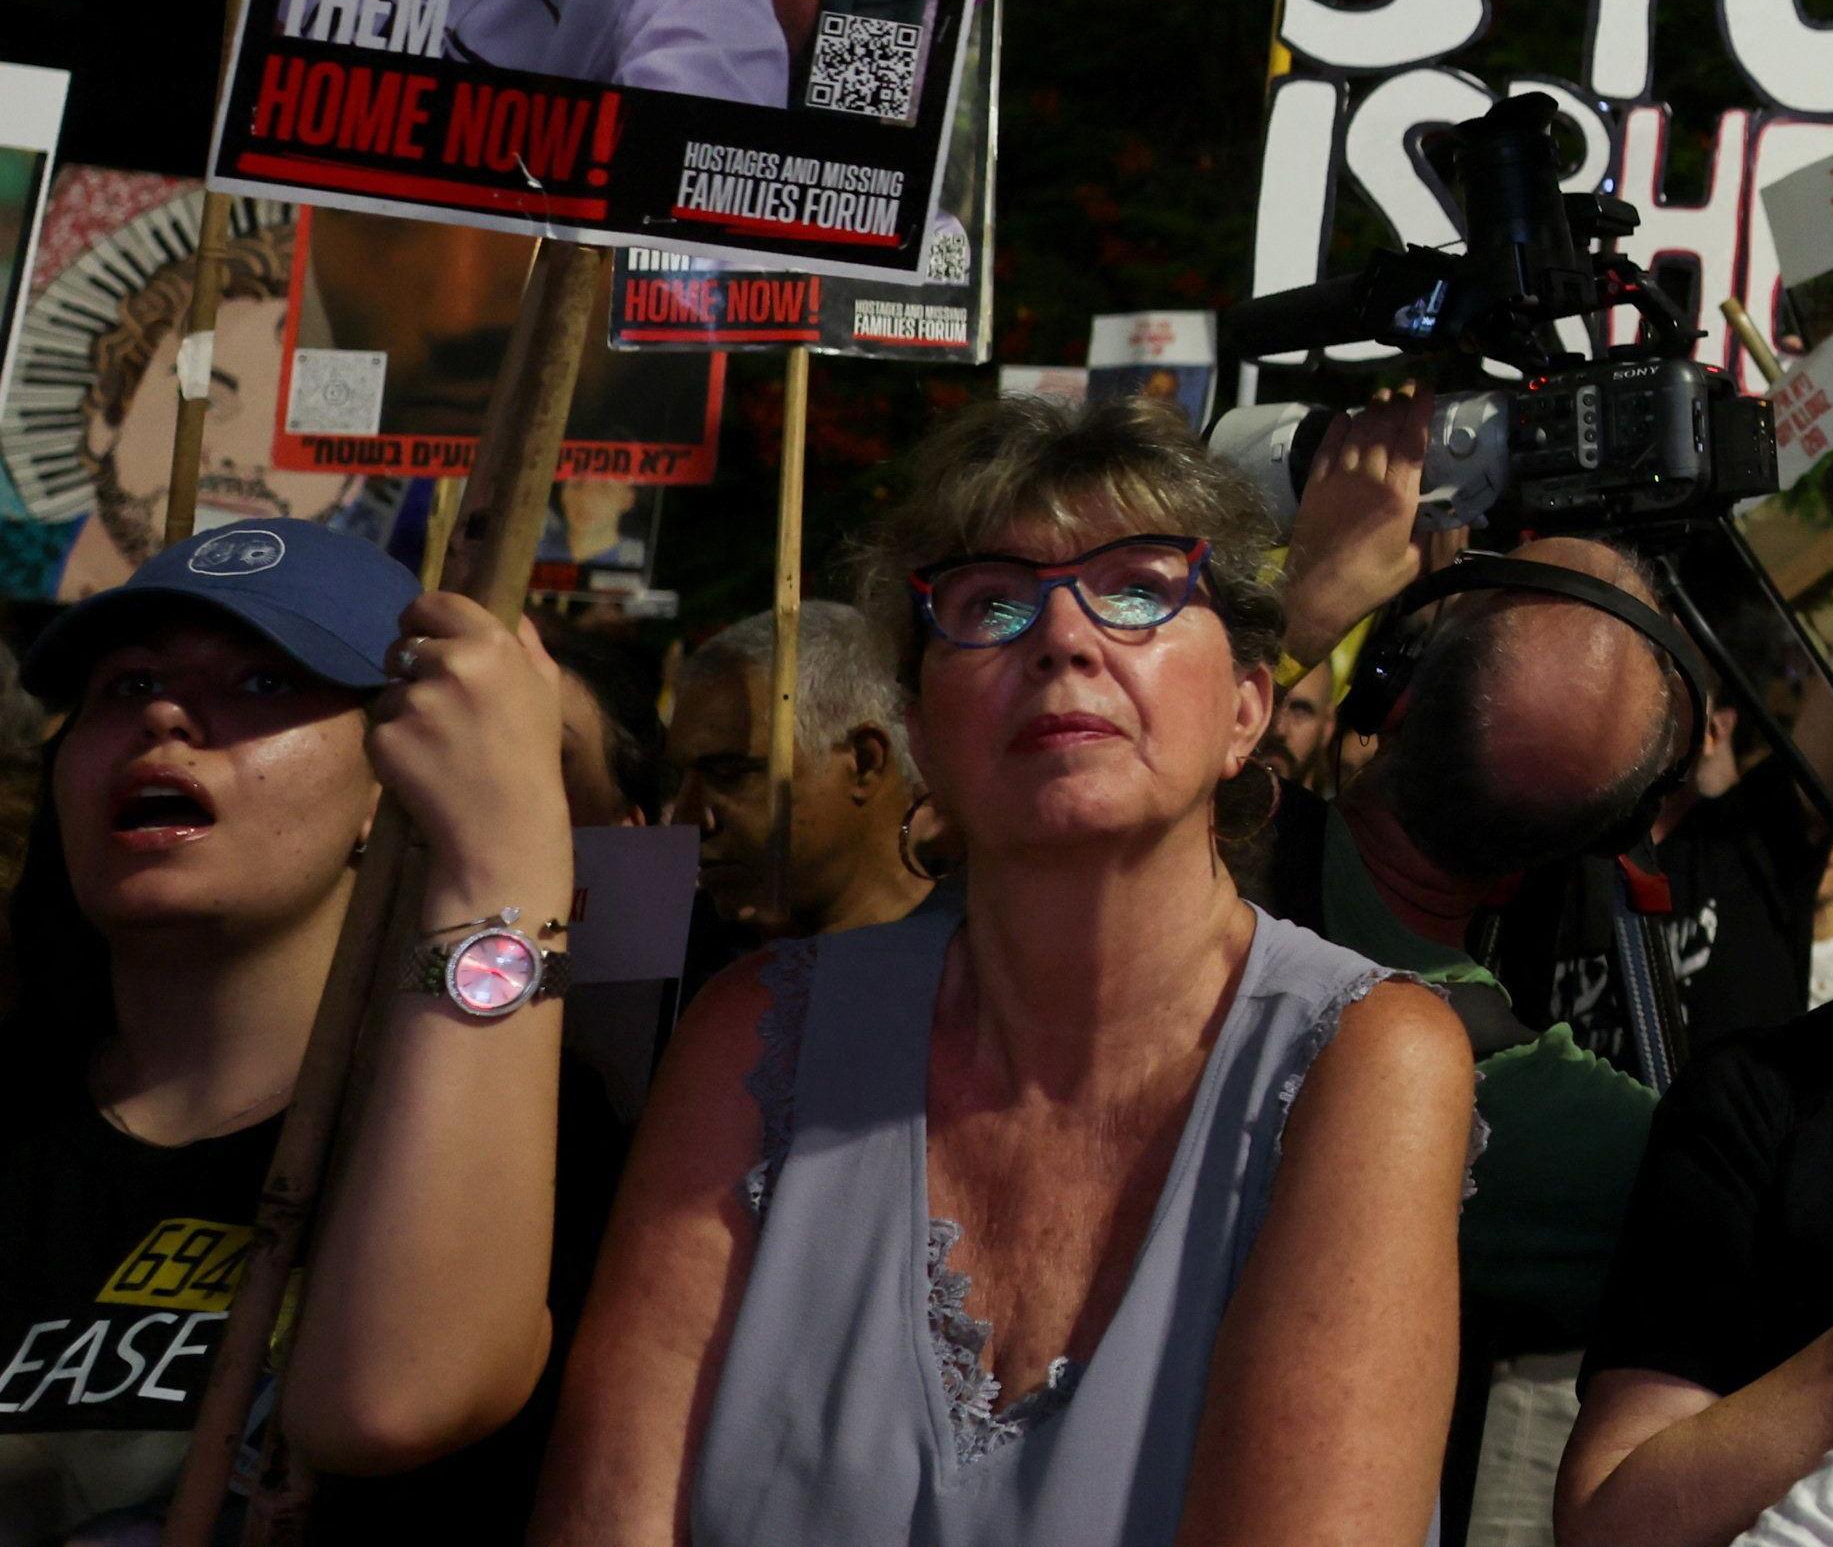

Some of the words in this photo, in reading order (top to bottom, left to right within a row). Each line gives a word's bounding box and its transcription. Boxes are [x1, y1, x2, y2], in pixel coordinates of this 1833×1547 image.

[254, 53, 438, 161] HOME
[441, 83, 622, 187] NOW!
[684, 140, 784, 186] HOSTAGES
[780, 157, 821, 190] AND
[822, 162, 906, 199] MISSING
[677, 170, 801, 225] FAMILIES
[802, 190, 899, 240] FORUM
[624, 279, 726, 324] HOME
[726, 276, 822, 324] NOW!
[853, 314, 913, 340] FAMILIES
[916, 319, 968, 345] FORUM
[1612, 365, 1660, 381] SONY
